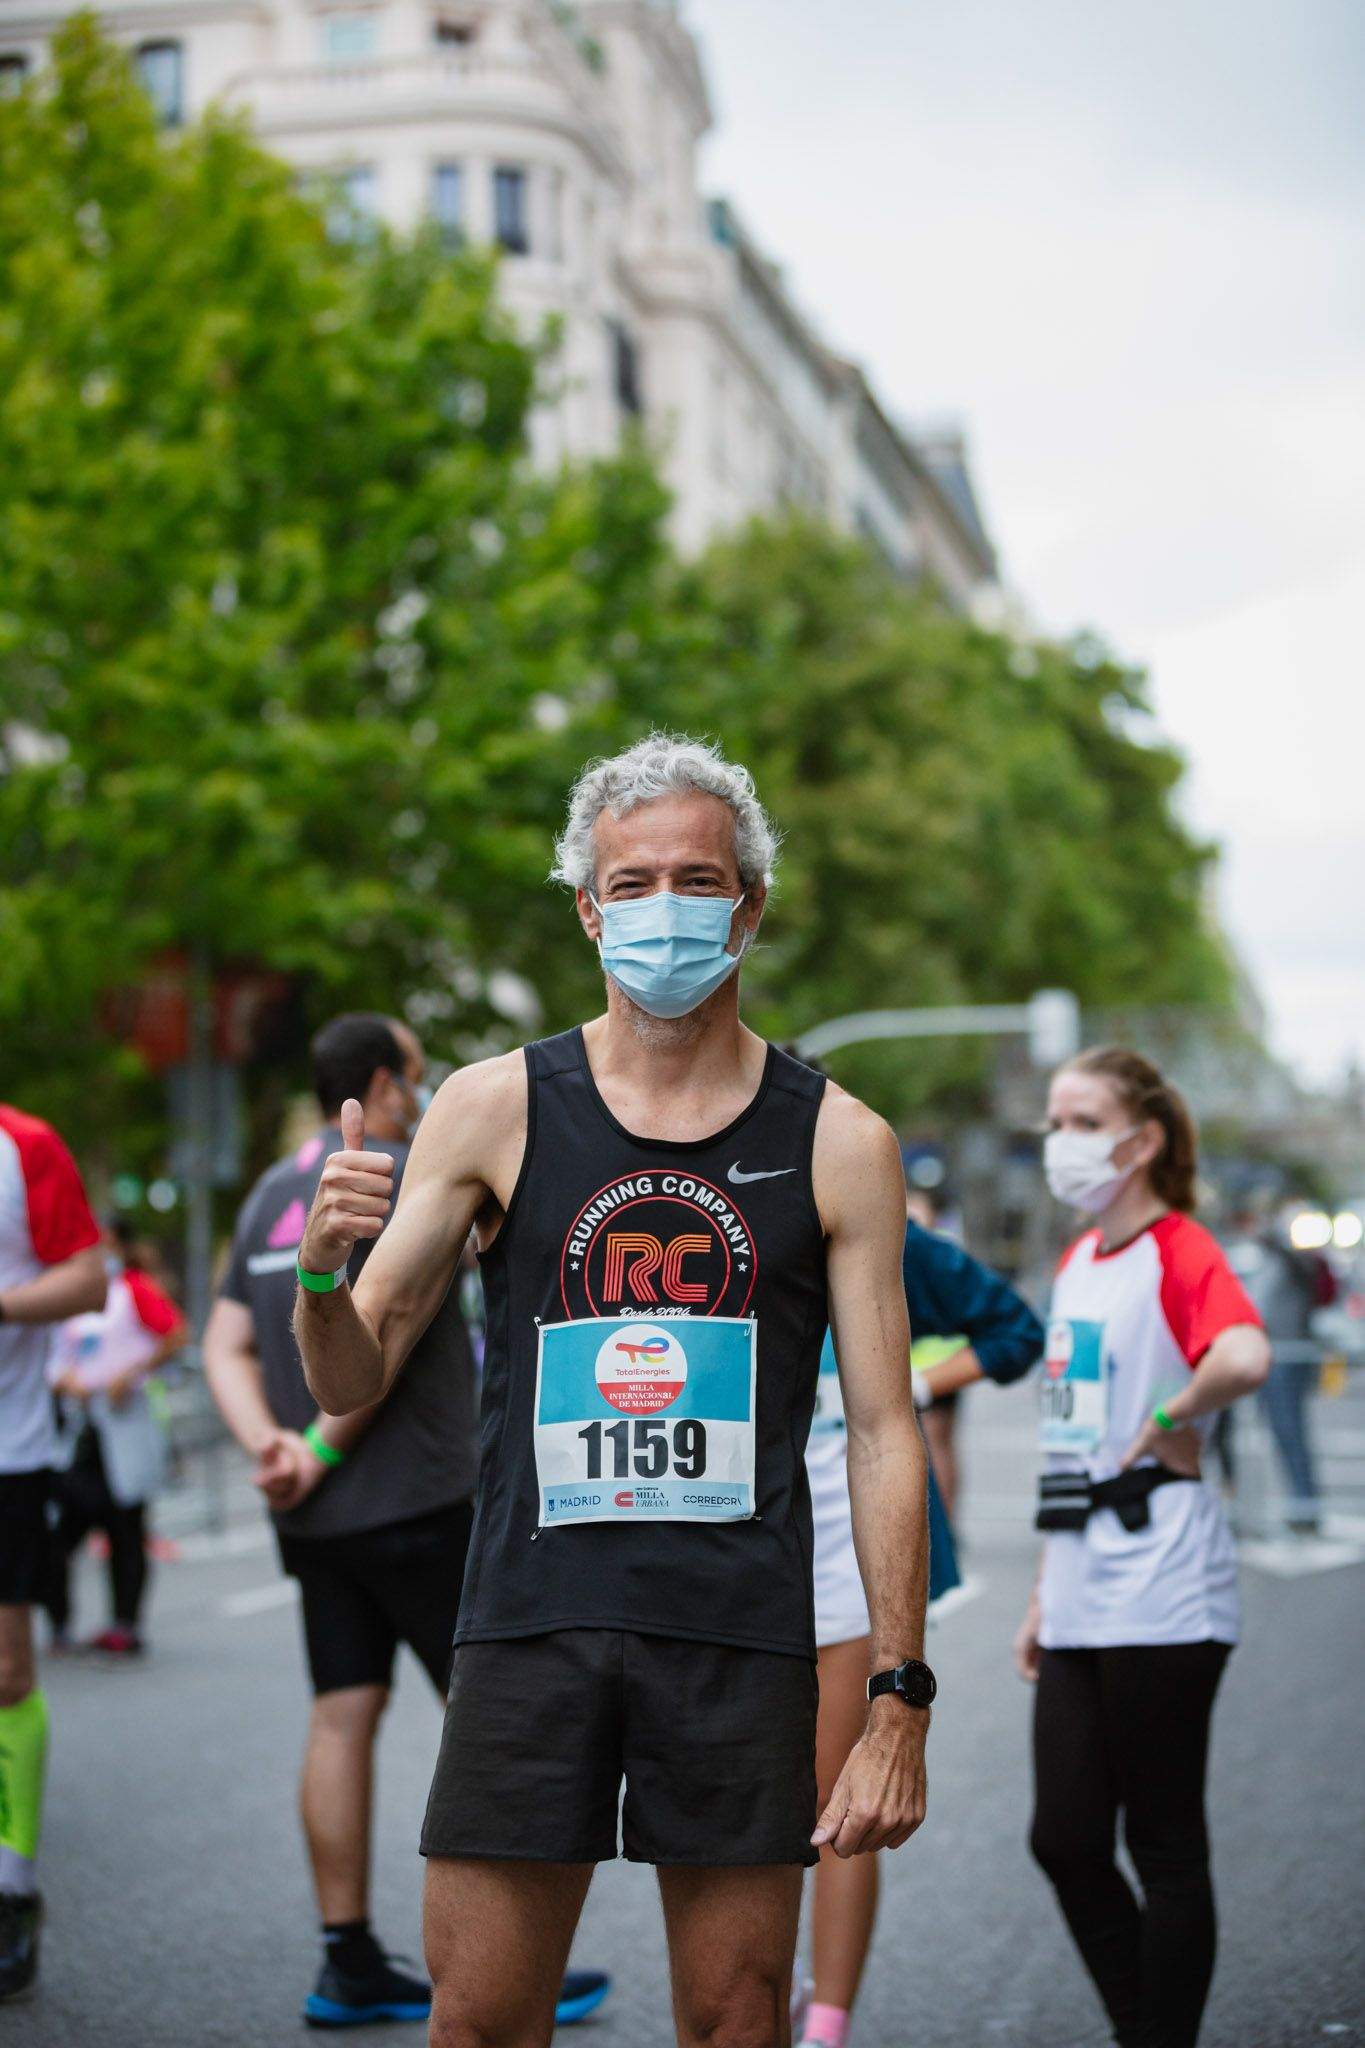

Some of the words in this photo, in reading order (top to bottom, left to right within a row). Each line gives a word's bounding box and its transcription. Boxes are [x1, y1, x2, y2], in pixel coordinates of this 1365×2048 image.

[569, 1177, 653, 1256] RUNNING
[661, 1176, 751, 1255] COMPANY
[603, 1233, 711, 1303] RC
[615, 1368, 671, 1377] TotalEnergies
[609, 1392, 674, 1400] INTERNACIONAL
[632, 1400, 664, 1408] MADRID
[578, 1418, 707, 1480] 1159
[560, 1495, 601, 1508] MADRID
